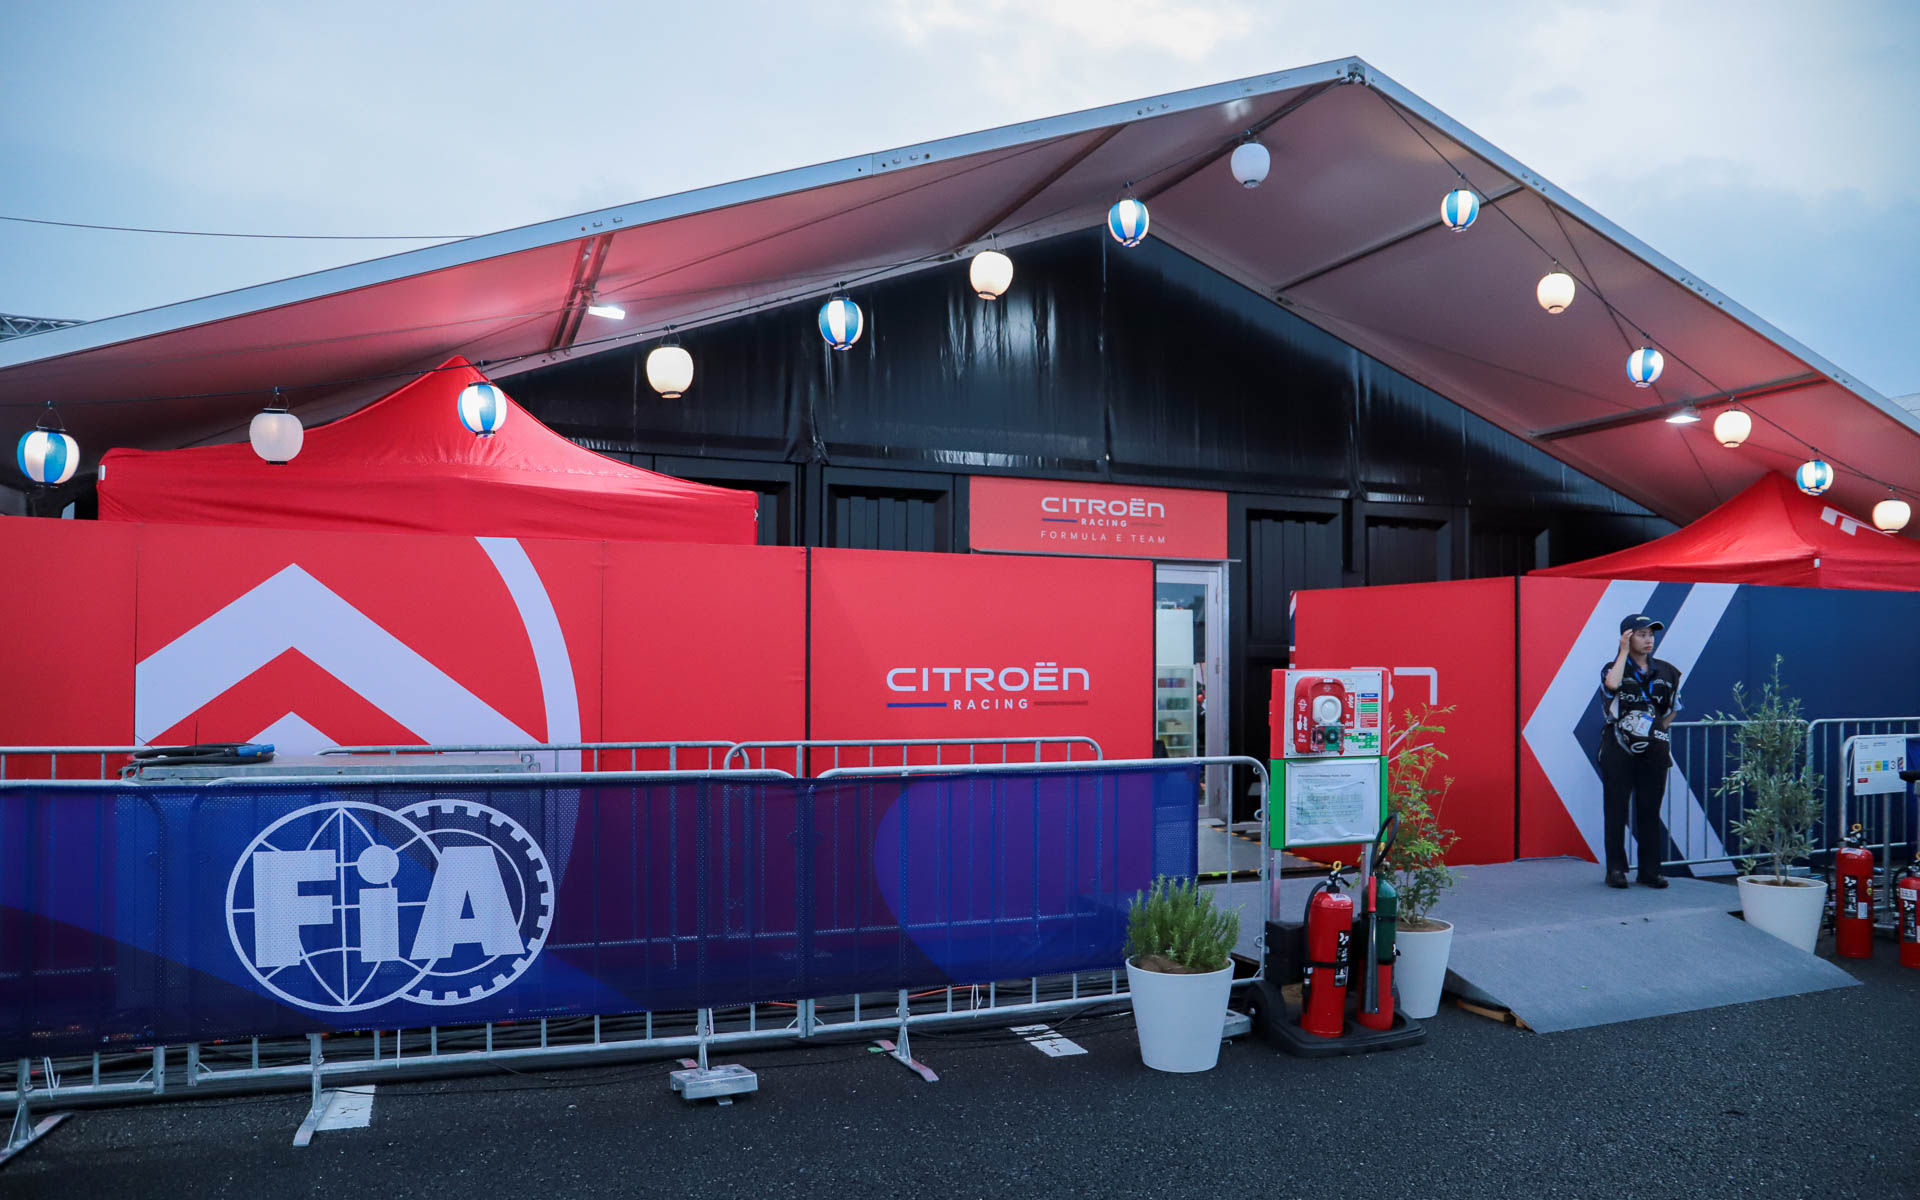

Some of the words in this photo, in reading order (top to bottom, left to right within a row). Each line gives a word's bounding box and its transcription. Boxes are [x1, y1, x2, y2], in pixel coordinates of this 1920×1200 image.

[1081, 518, 1128, 528] RACING
[1040, 530, 1107, 542] FORMULA
[1116, 534, 1122, 542] E
[1131, 534, 1166, 544] TEAM
[953, 698, 1029, 710] RACING
